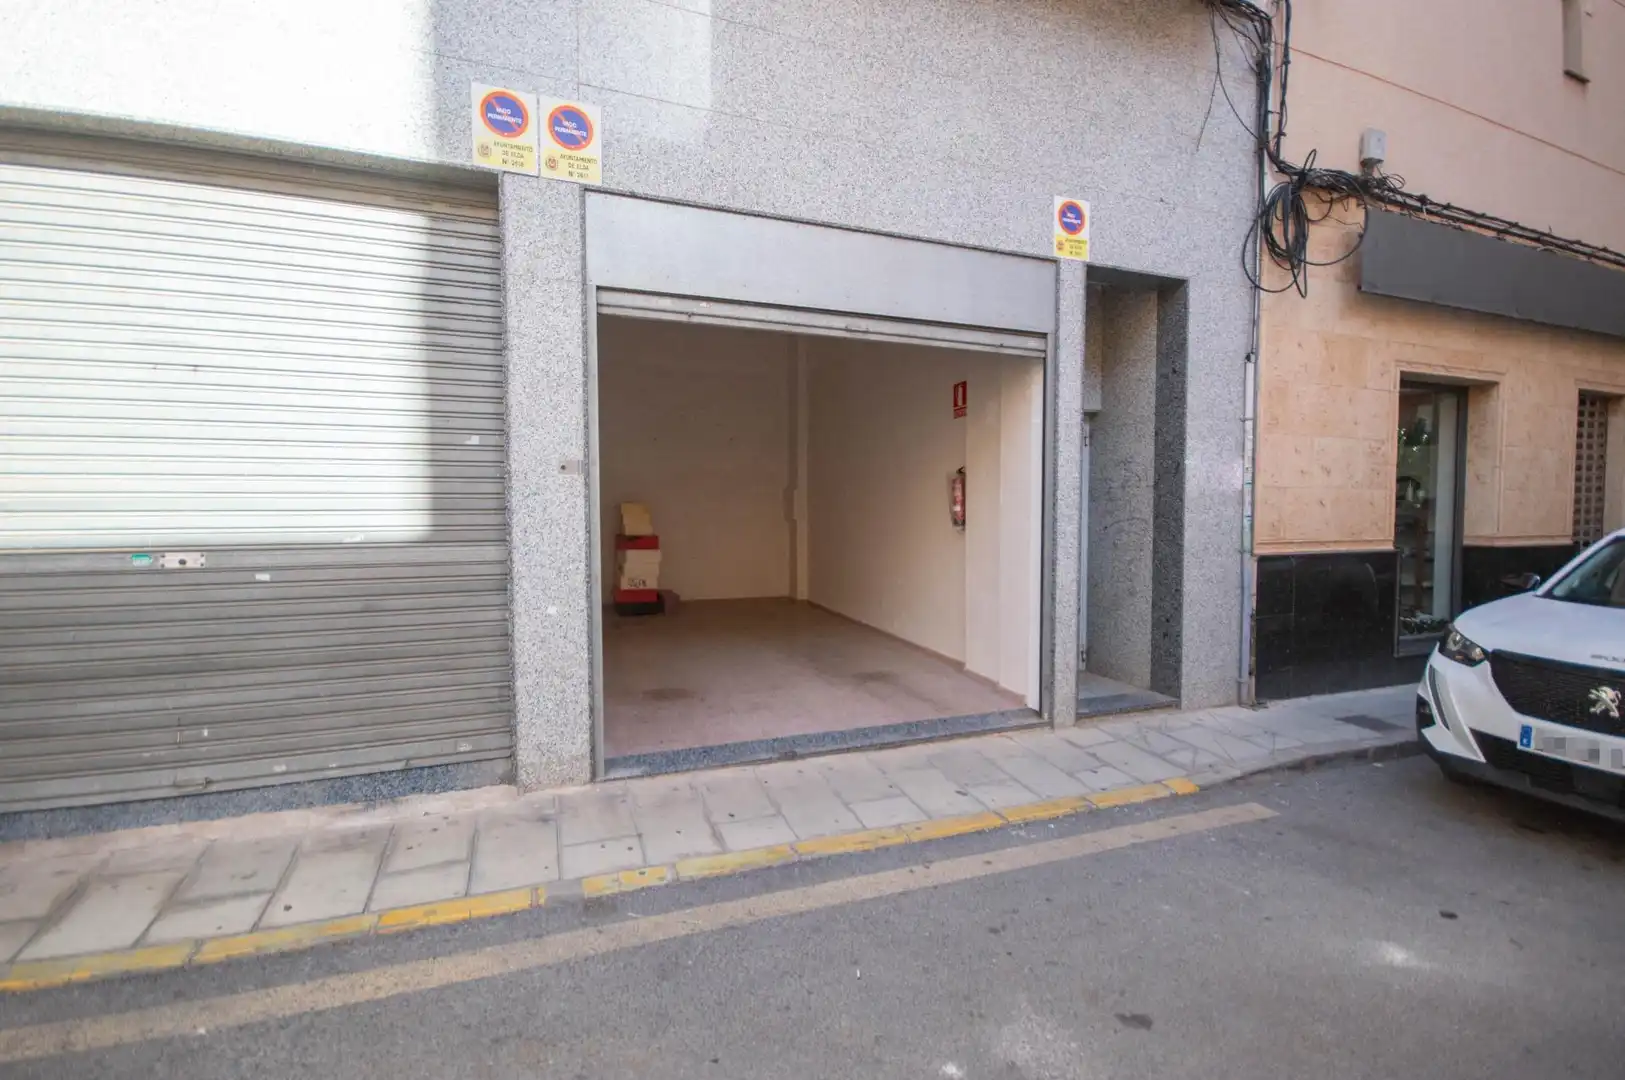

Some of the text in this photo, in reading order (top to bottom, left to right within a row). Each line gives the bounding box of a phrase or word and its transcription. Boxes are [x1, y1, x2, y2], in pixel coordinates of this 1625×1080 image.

[487, 113, 522, 124] PERMANENTE
[554, 126, 587, 137] PERMANENTE
[493, 140, 534, 153] AYUNTAMIENTO
[560, 153, 598, 165] AYUNTAMIENTO
